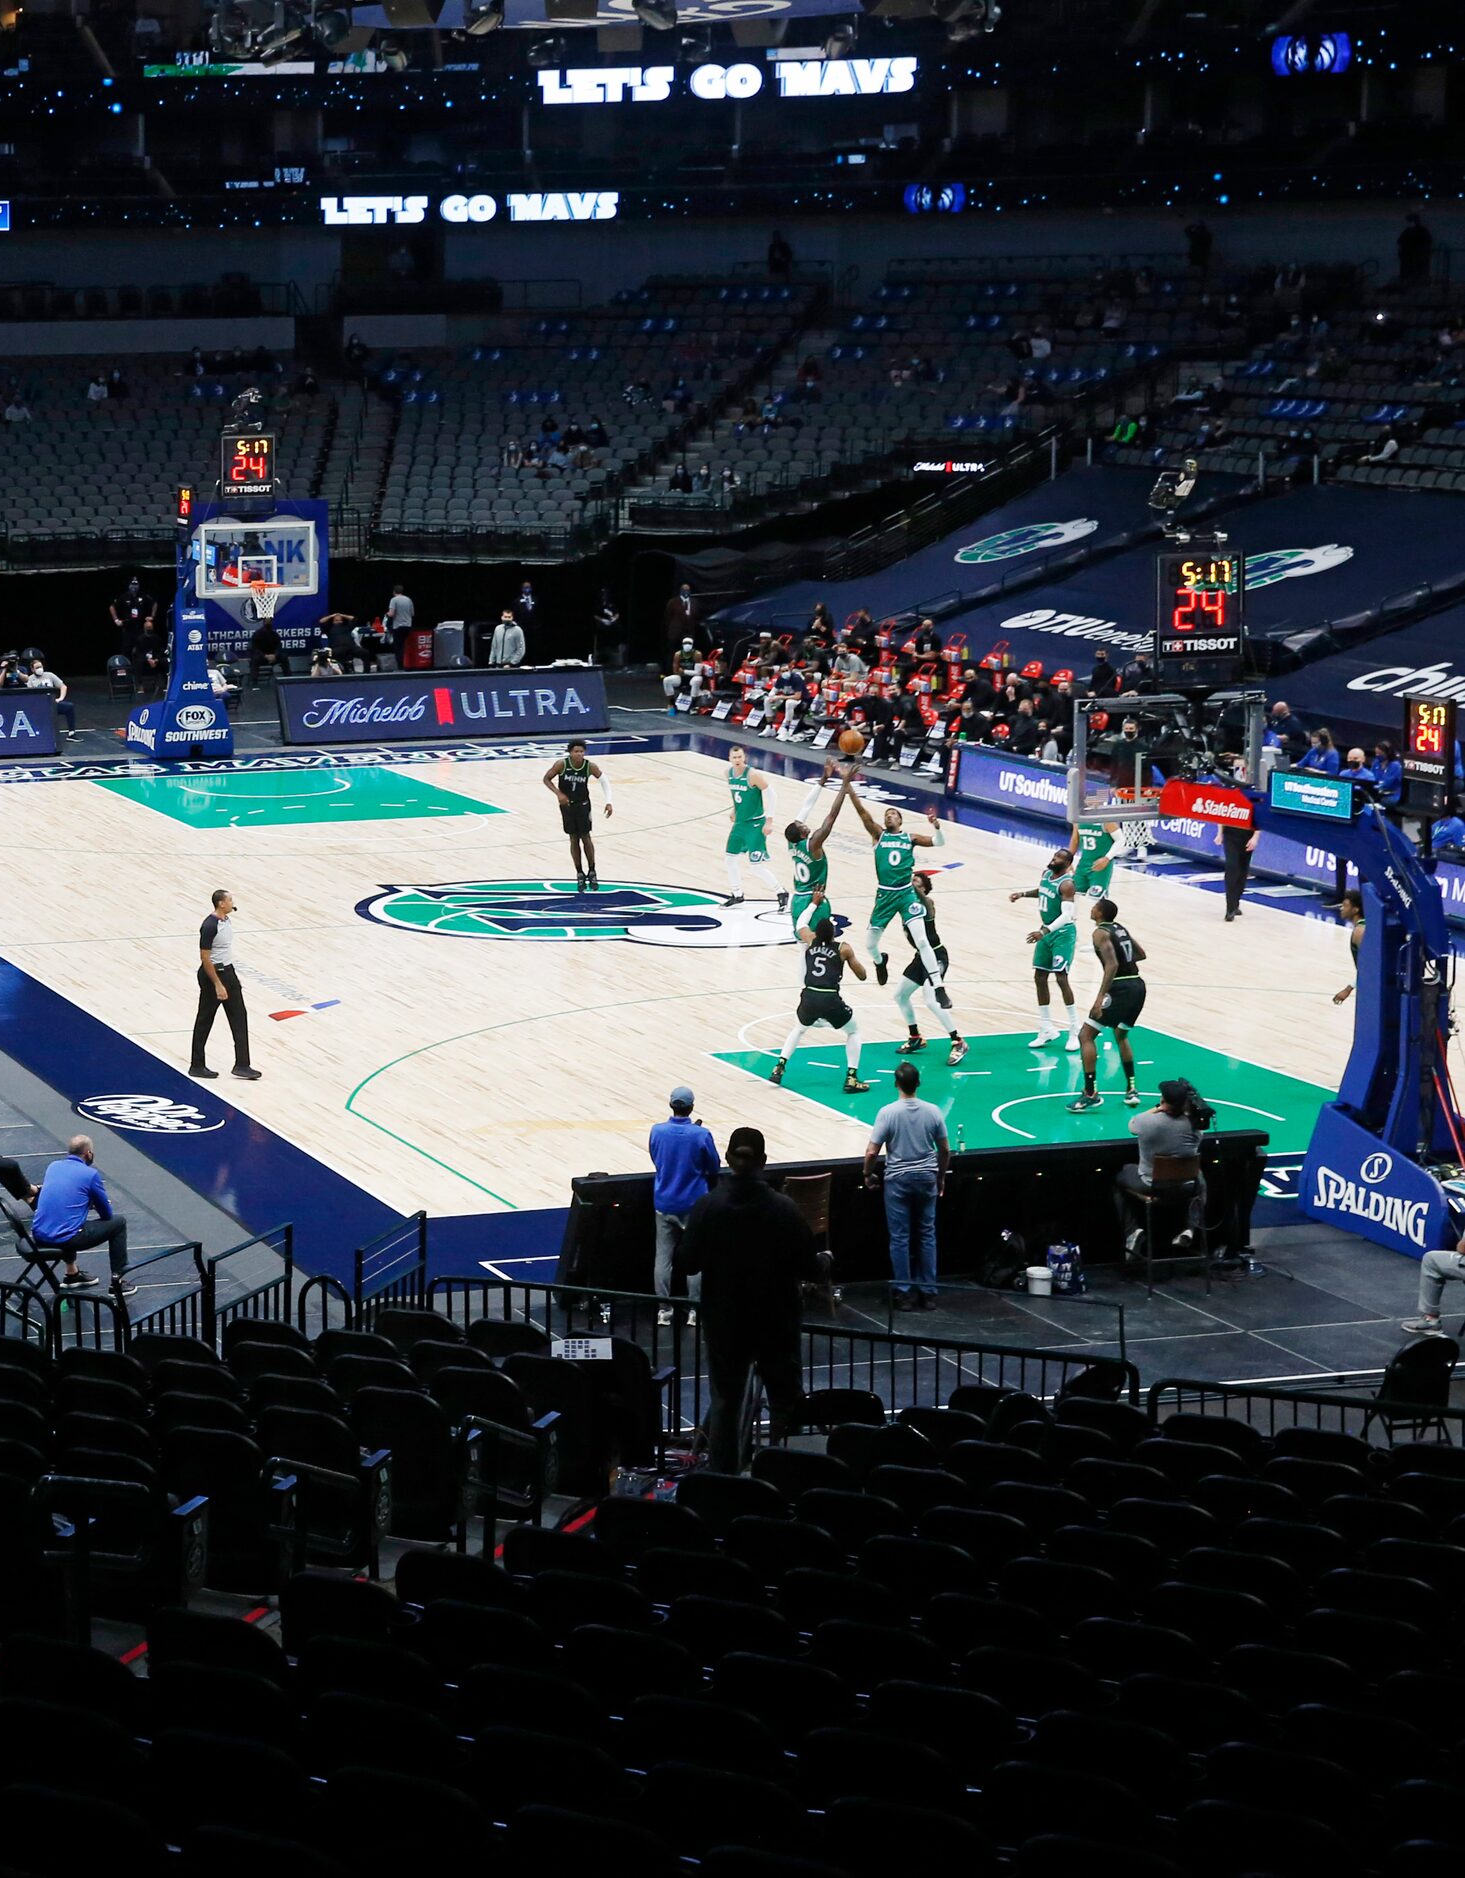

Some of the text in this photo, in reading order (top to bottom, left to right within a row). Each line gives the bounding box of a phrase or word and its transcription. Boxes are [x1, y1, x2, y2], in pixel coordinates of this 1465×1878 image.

[537, 57, 918, 104] LET'S GO MAVS
[320, 192, 618, 224] LET'S GO MAVS
[236, 439, 268, 456] 5:17
[232, 456, 267, 481] 24
[239, 484, 272, 493] TISSOT
[1181, 560, 1231, 586] 5:17
[1174, 588, 1225, 630] 24
[1183, 638, 1237, 651] TISSOT
[182, 681, 209, 691] chime
[185, 711, 206, 721] FOX
[302, 687, 587, 729] Michelob ULTRA
[127, 721, 157, 750] SPALDING
[165, 729, 228, 742] SOUTHWEST
[1416, 725, 1439, 751] 24
[1416, 760, 1445, 775] TISSOT
[564, 774, 586, 782] MINN
[571, 782, 577, 791] 1
[734, 791, 742, 804] 6
[1082, 837, 1096, 850] 13
[888, 850, 902, 866] 0
[1384, 866, 1413, 909] SPALDING
[1039, 895, 1048, 913] 11
[809, 944, 837, 958] BEASLEY
[1120, 940, 1133, 962] 17
[811, 957, 827, 977] 5
[1313, 1166, 1429, 1247] SPALDING
